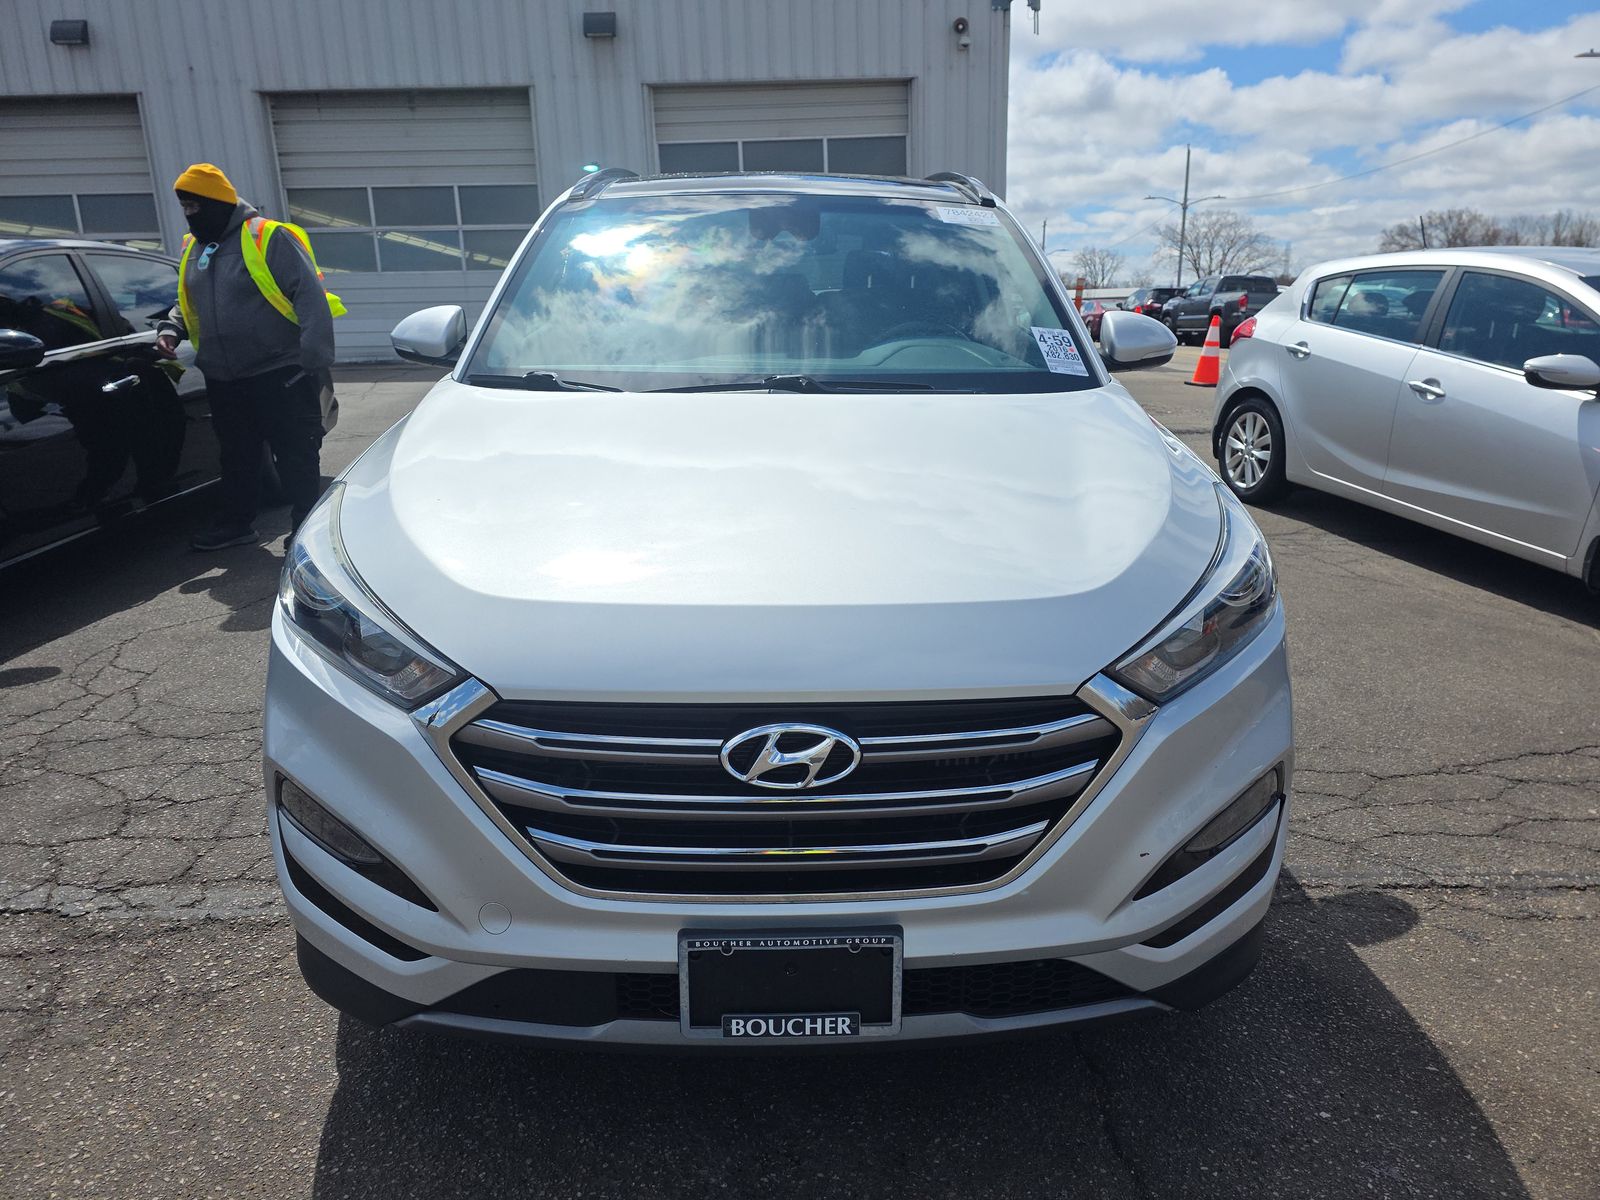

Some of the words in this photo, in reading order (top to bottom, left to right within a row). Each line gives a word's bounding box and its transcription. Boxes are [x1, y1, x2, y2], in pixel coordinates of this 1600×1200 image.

[1039, 334, 1073, 347] 4:59
[759, 939, 838, 947] AUTOMOTIVE
[731, 1017, 852, 1036] BOUCHER
